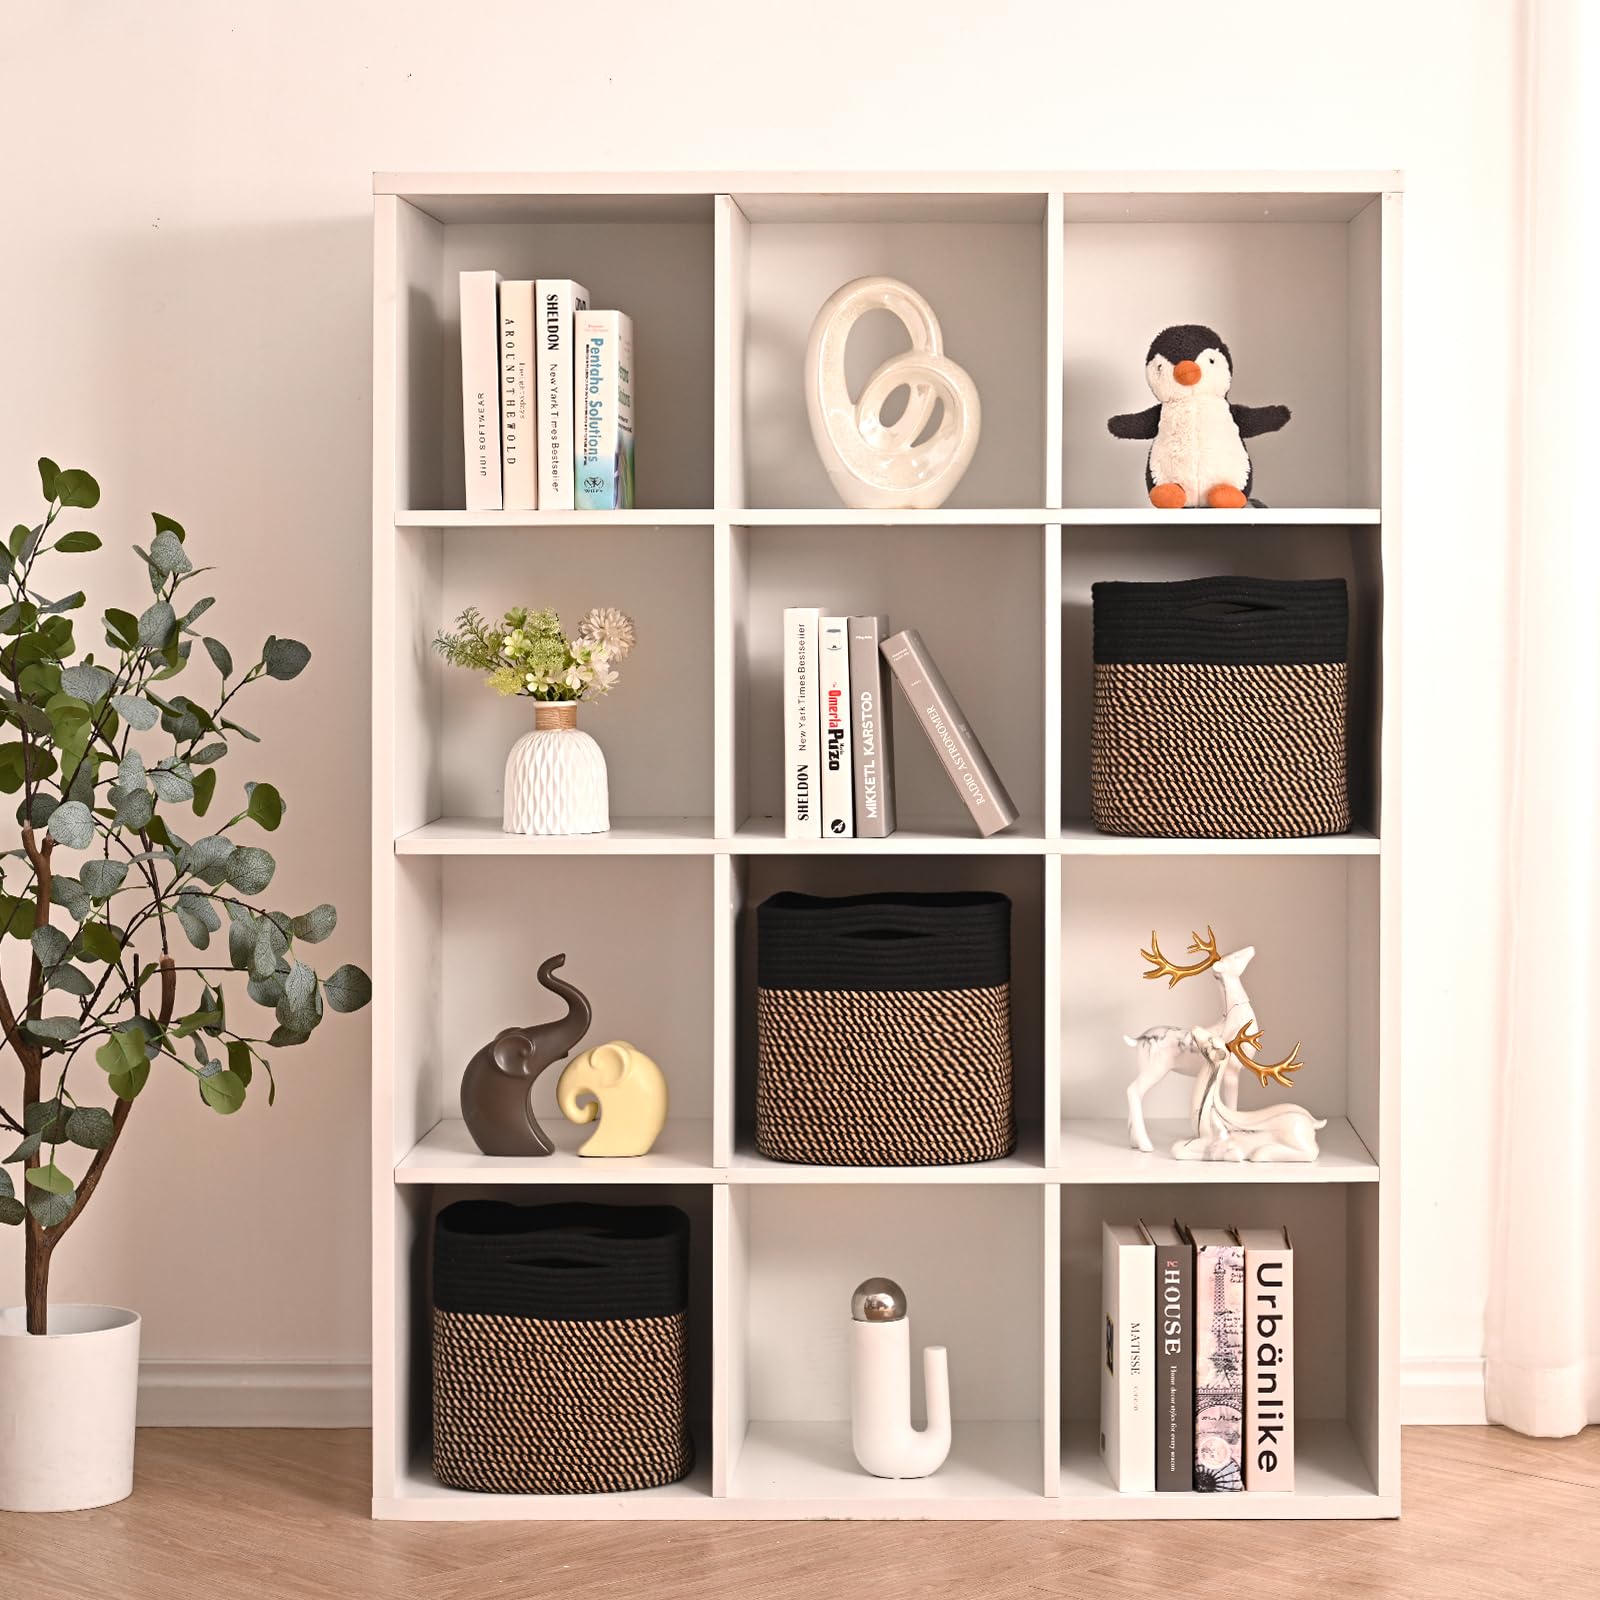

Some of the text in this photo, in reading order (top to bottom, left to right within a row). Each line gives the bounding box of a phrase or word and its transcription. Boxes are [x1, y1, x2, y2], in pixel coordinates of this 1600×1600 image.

[546, 293, 560, 351] SHELDON
[549, 363, 558, 386] New
[589, 338, 604, 394] Pentaho
[588, 400, 603, 462] Solutions
[797, 674, 806, 704] Times
[828, 690, 842, 728] Omerta
[798, 730, 807, 751] New
[828, 729, 844, 771] Puzo
[860, 691, 878, 819] MIKKETL KARSTOD
[926, 704, 985, 806] RADIO ASTRONOMER
[797, 764, 809, 821] SHELDON
[1164, 1270, 1181, 1355] HOUSE
[1130, 1322, 1141, 1375] MATISSE
[1256, 1262, 1284, 1473] Urbänlike
[1168, 1433, 1176, 1450] every
[1169, 1423, 1178, 1432] for
